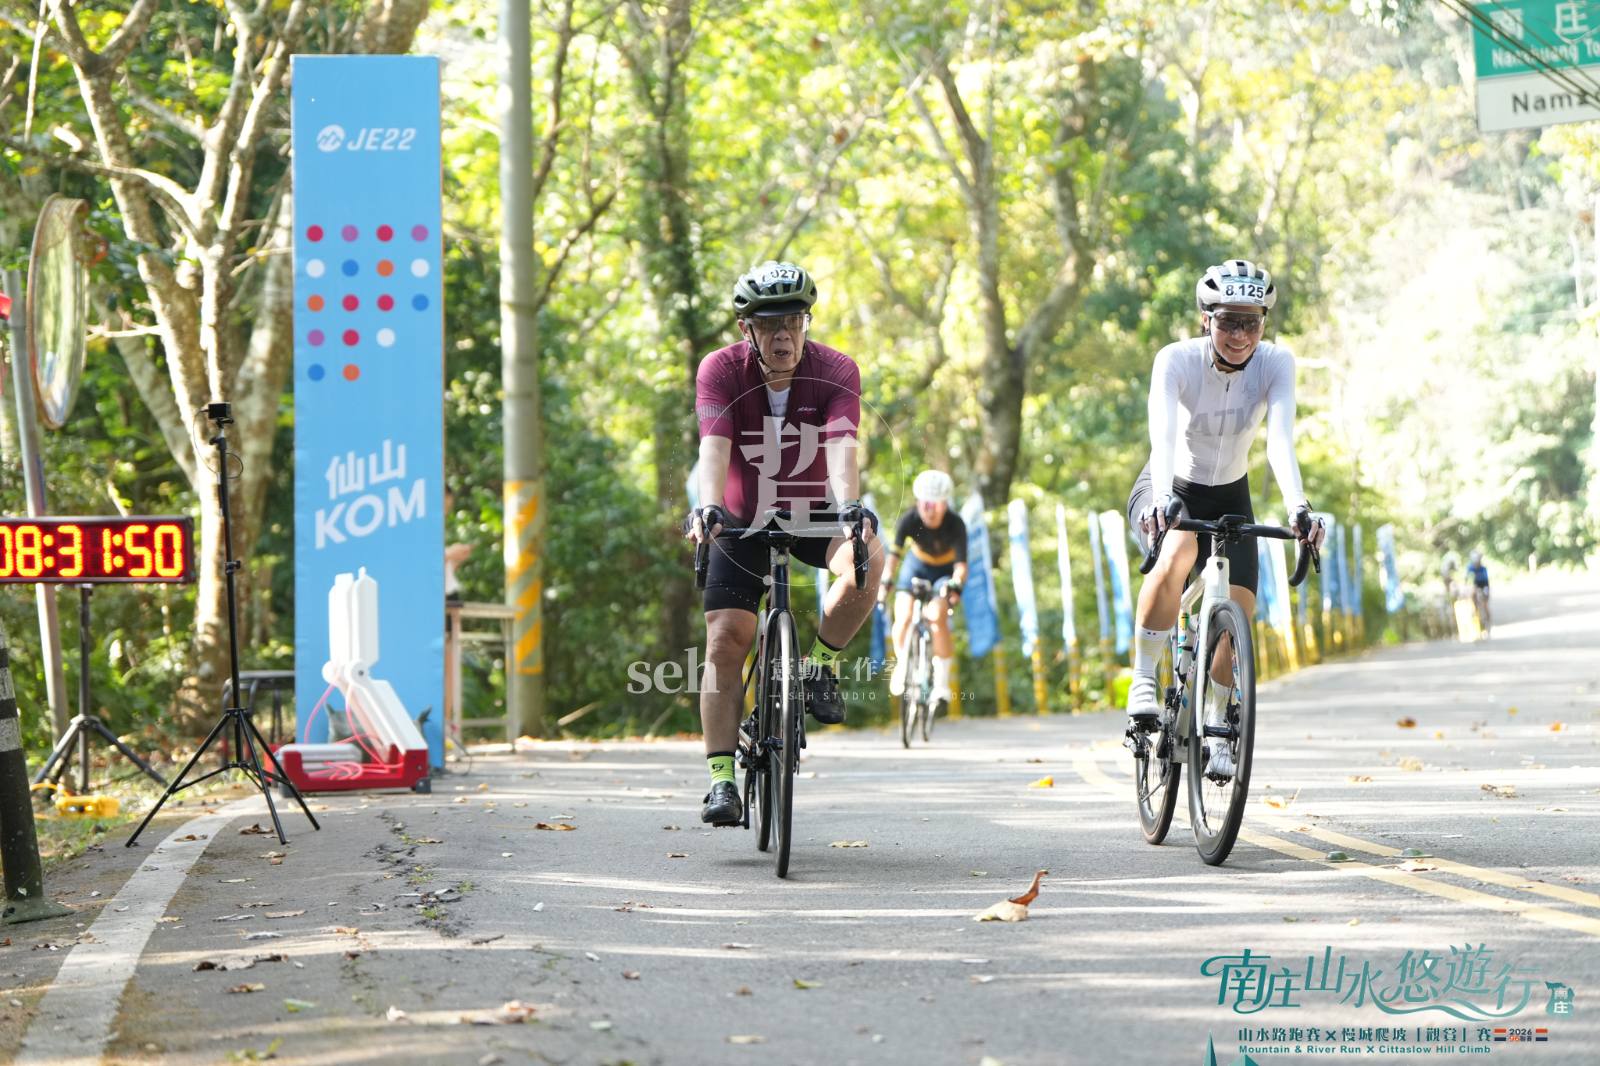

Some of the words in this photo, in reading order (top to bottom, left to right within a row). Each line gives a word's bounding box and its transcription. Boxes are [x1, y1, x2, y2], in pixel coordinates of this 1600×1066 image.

[346, 127, 417, 151] JE22
[1225, 283, 1264, 299] 8.125
[324, 438, 406, 501] 仙山
[314, 477, 427, 551] KOM
